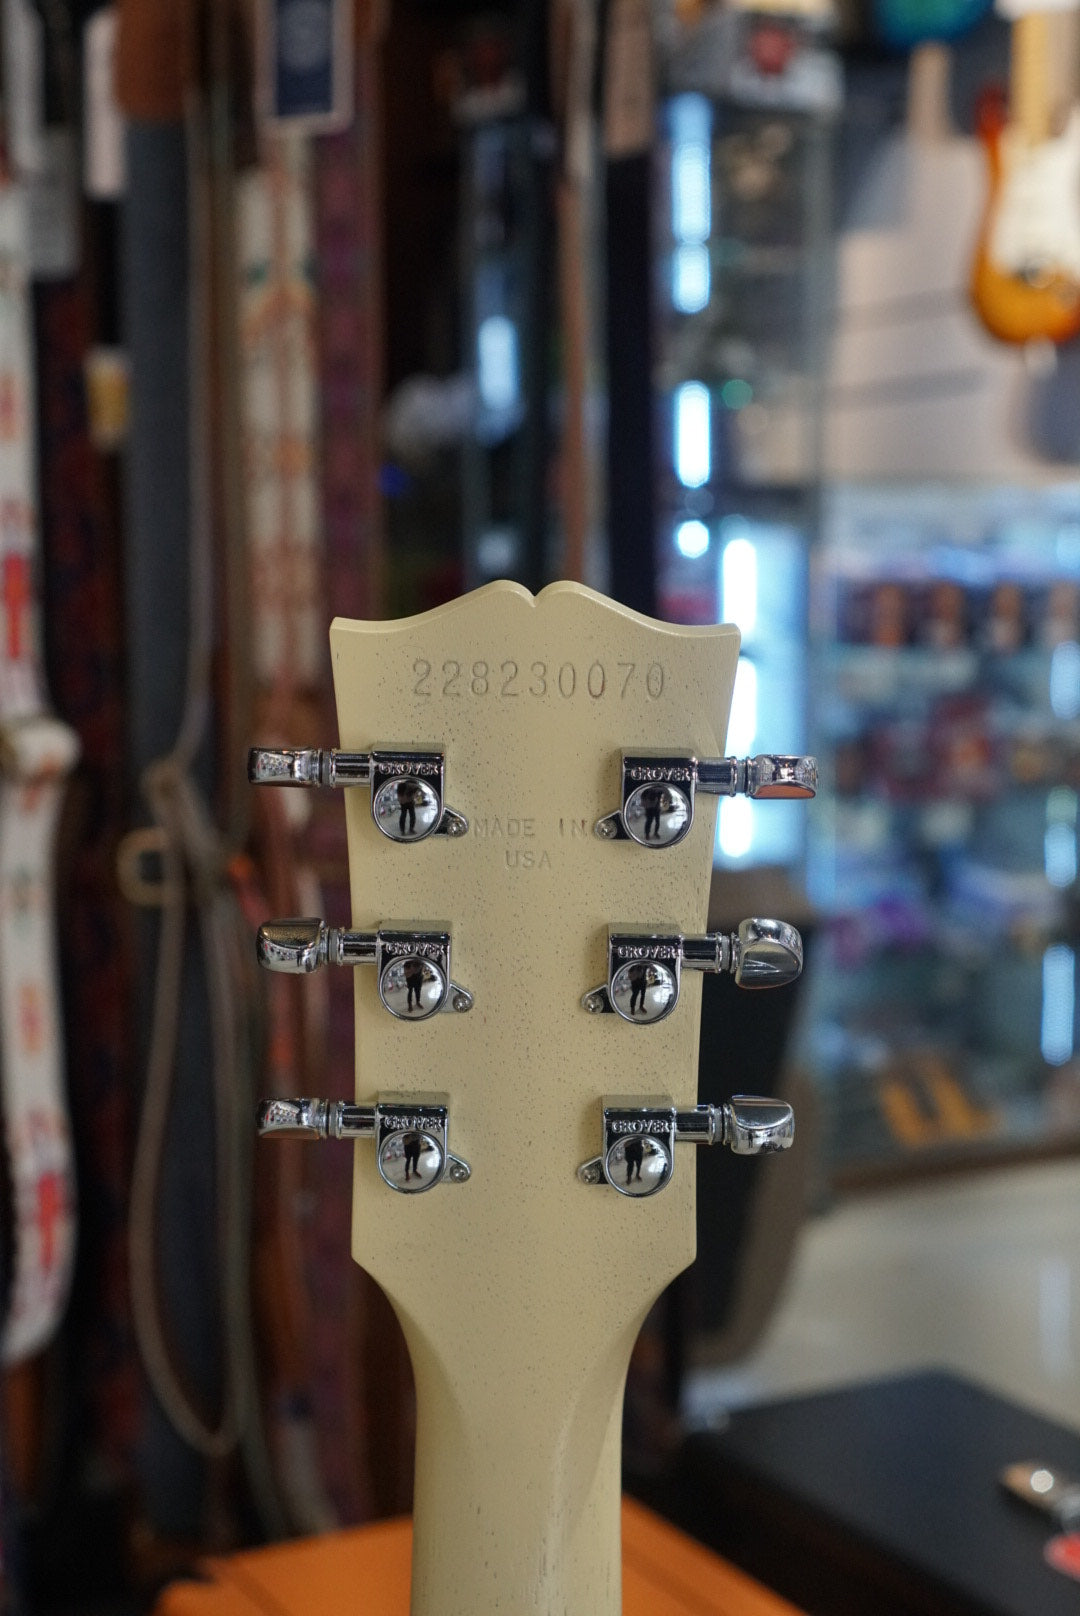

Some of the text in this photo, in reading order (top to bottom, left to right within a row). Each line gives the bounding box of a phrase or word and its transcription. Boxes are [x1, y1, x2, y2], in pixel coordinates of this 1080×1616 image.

[412, 658, 665, 700] 228230070
[378, 762, 440, 776] GROVER
[630, 766, 692, 782] GROVER
[474, 817, 588, 837] MADE IN
[505, 849, 552, 869] USA
[385, 941, 445, 956] GROVER
[617, 945, 678, 959] GROVER
[384, 1115, 443, 1130] GROVER
[611, 1119, 671, 1134] GROVER
